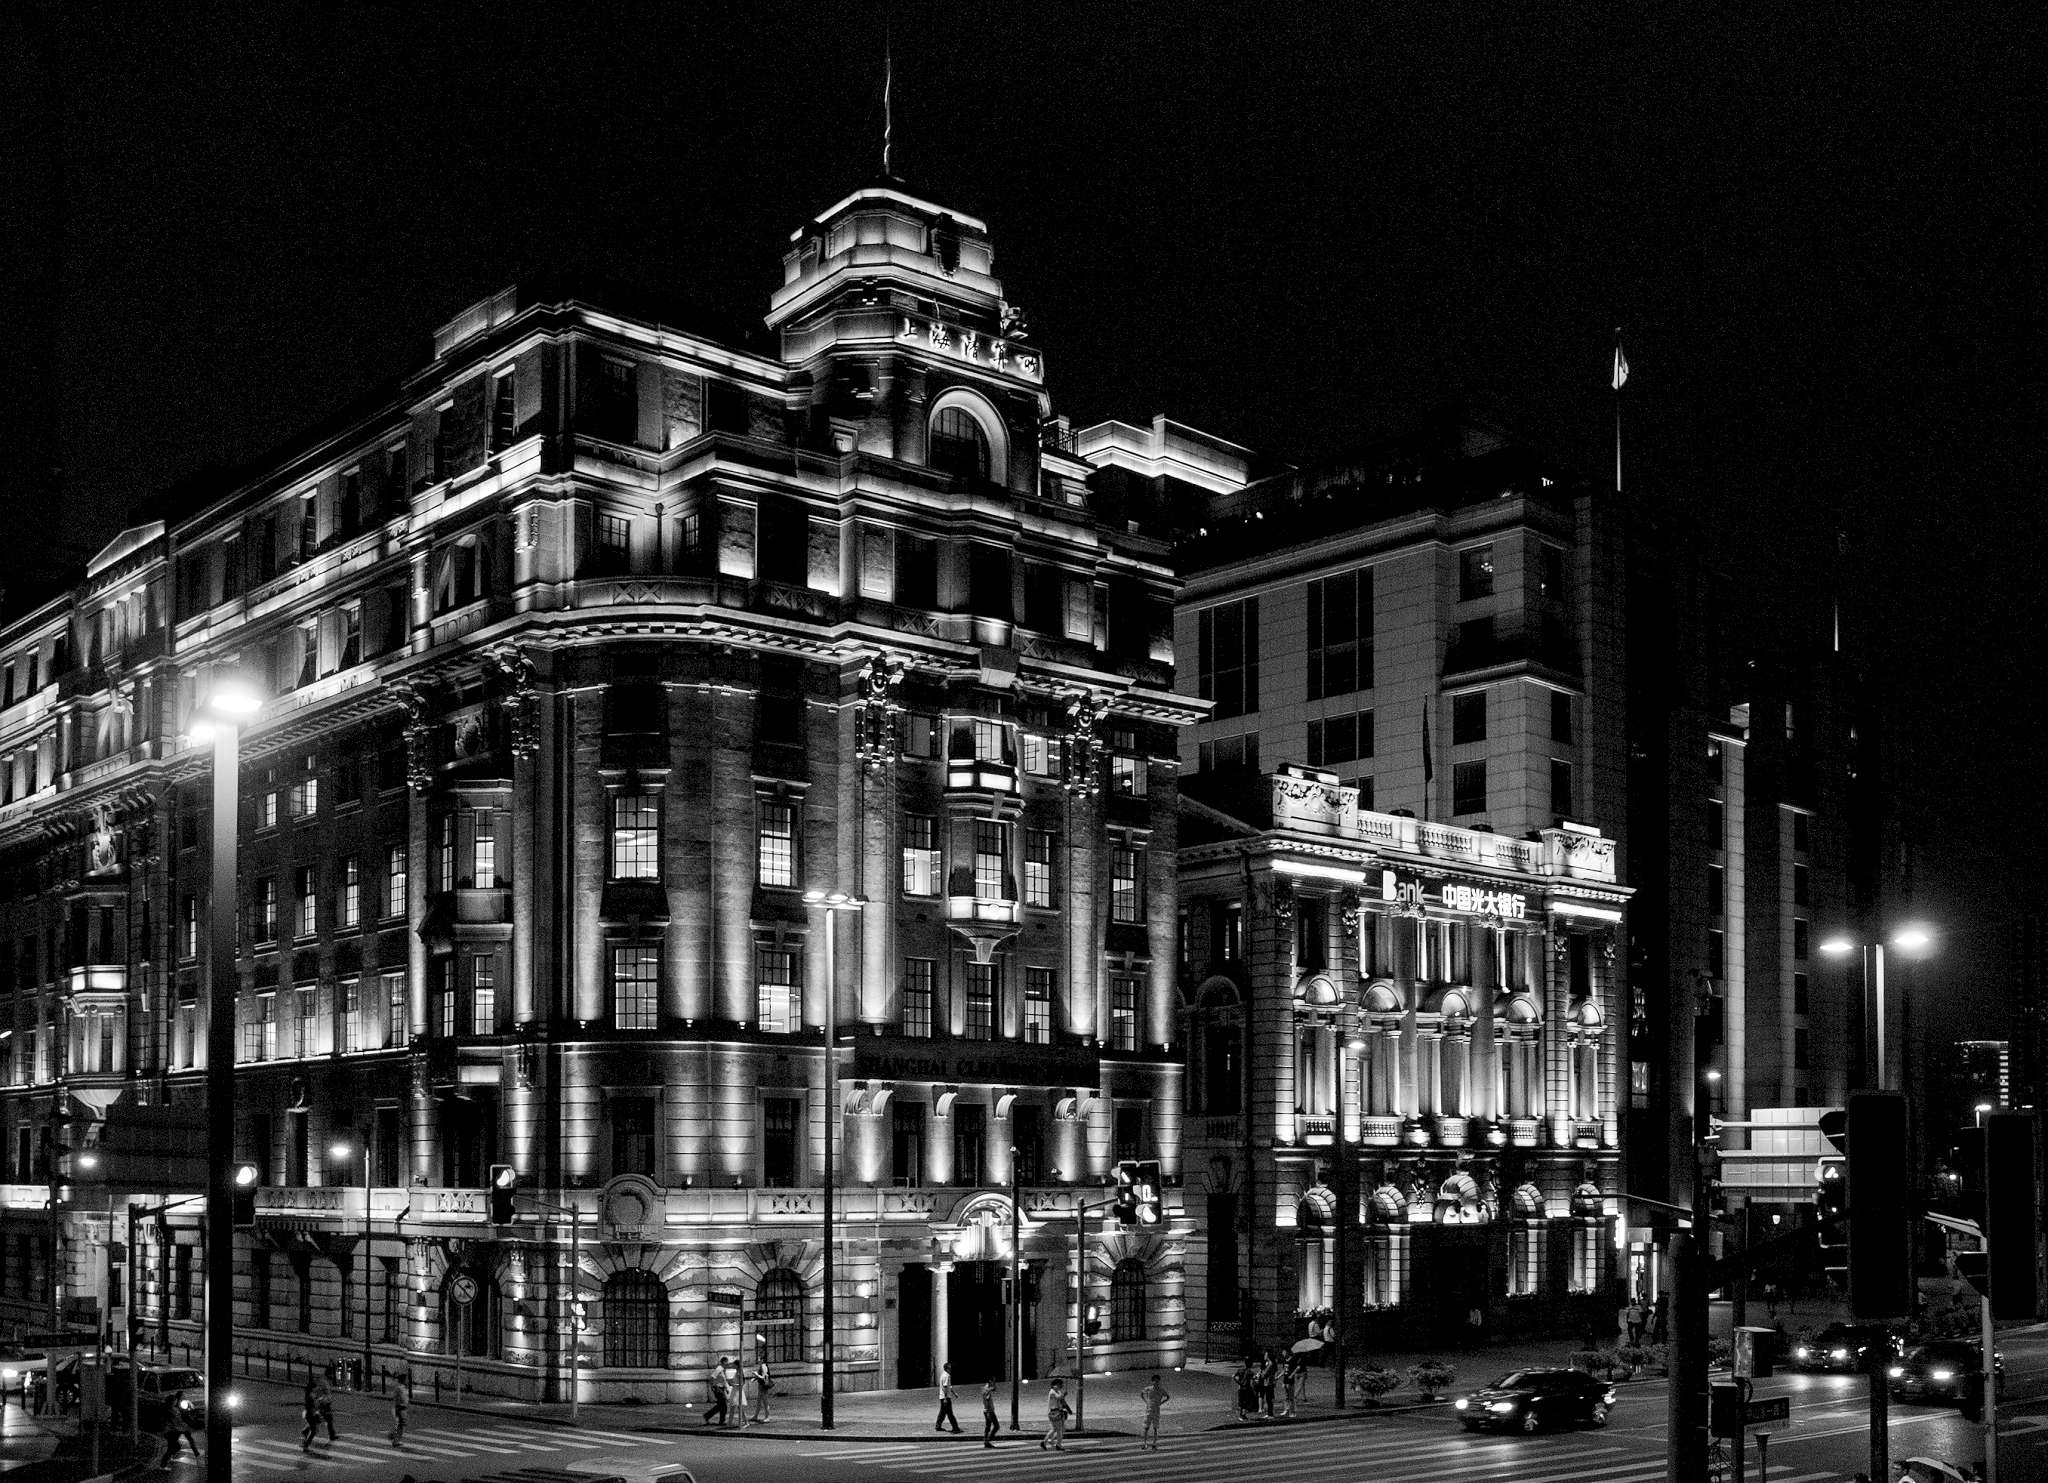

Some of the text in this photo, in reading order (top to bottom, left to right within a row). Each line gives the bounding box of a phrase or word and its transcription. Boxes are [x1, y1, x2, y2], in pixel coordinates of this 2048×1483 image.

[1382, 870, 1526, 918] Bank 中国光大银行
